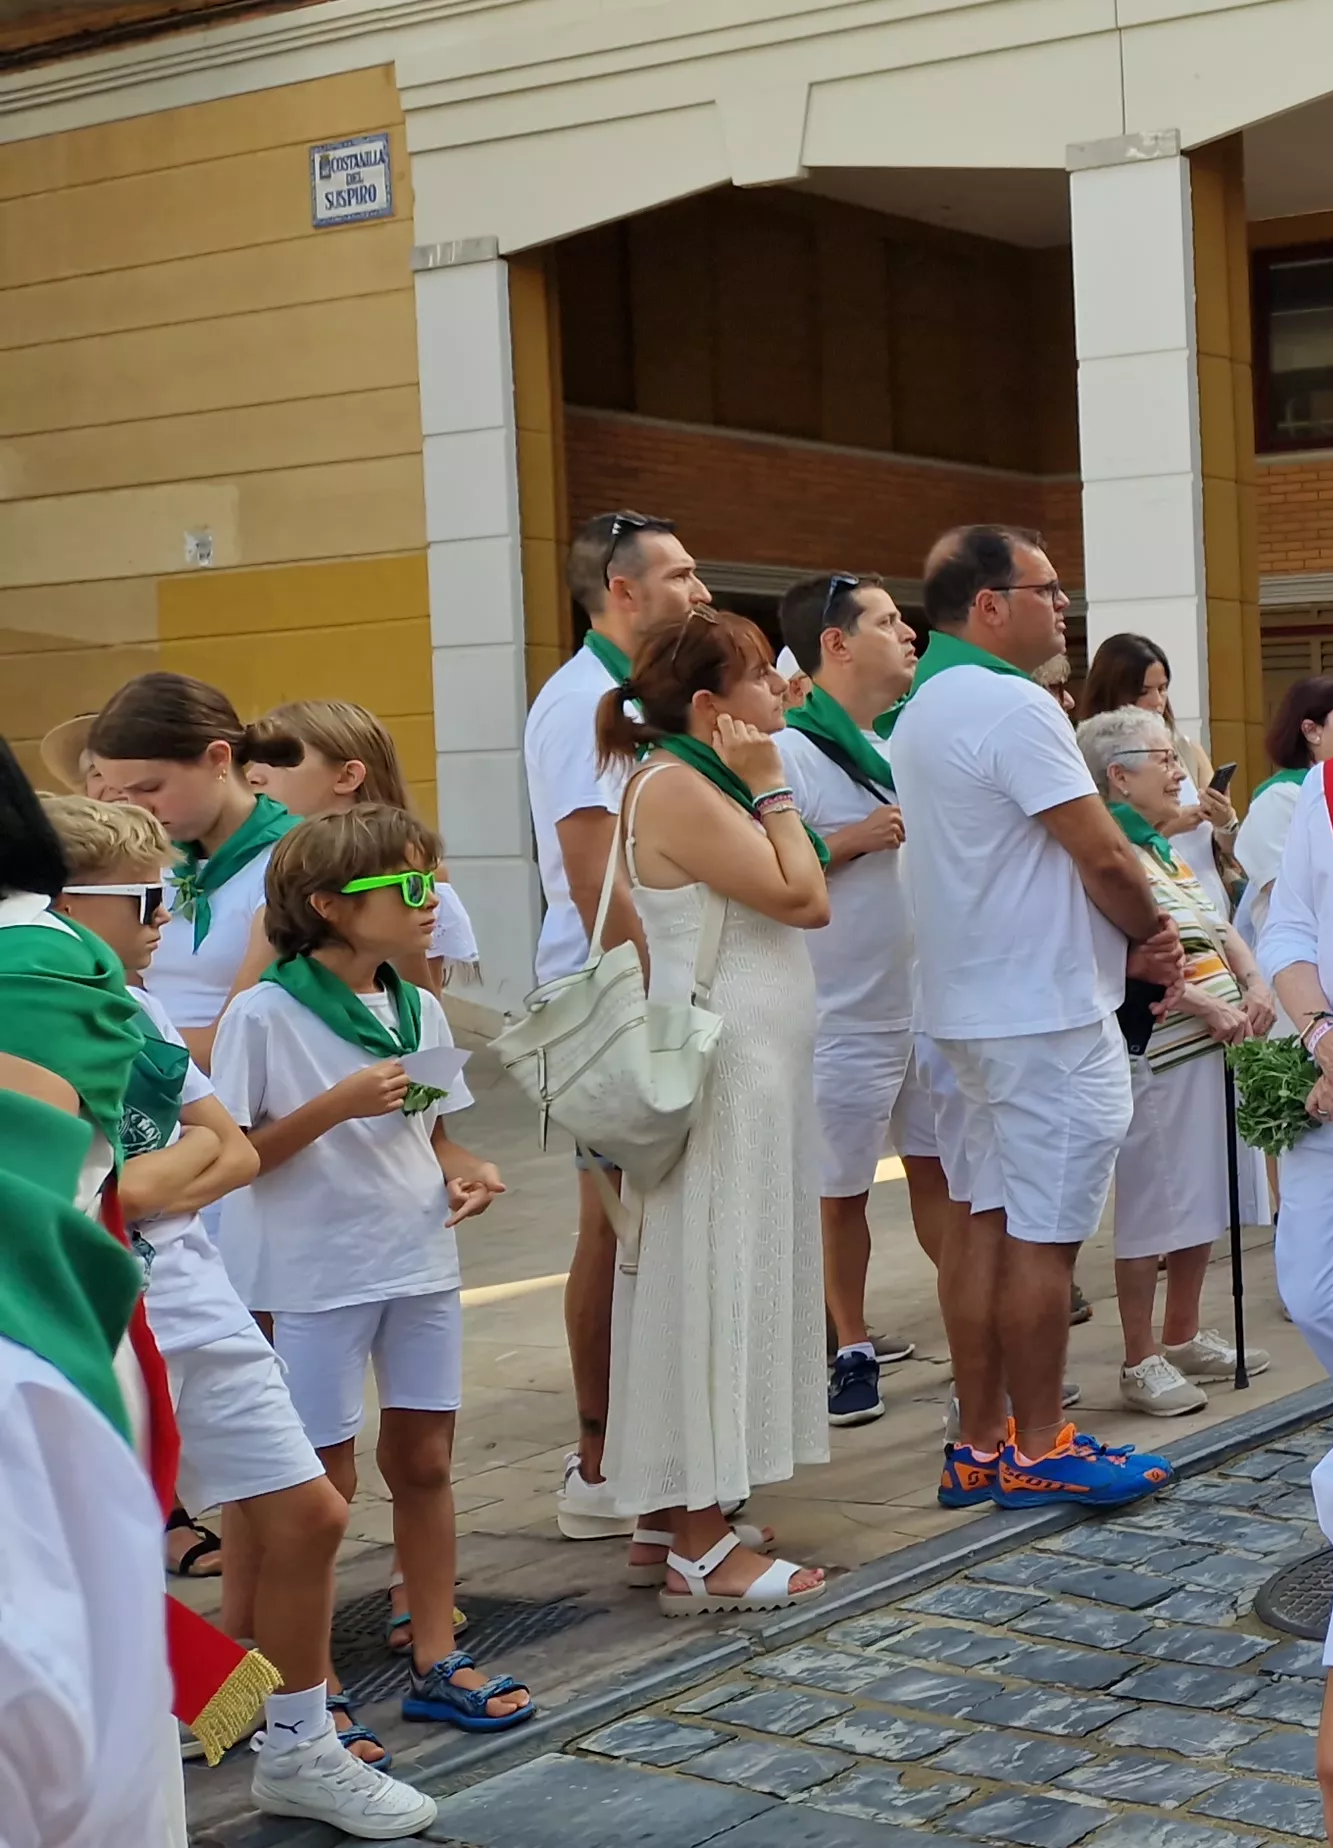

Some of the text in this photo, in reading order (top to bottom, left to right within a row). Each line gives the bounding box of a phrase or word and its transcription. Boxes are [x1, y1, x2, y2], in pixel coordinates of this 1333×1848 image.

[331, 149, 385, 172] COSTANILLA
[345, 171, 364, 186] DEL
[324, 184, 377, 210] SUSPIRO
